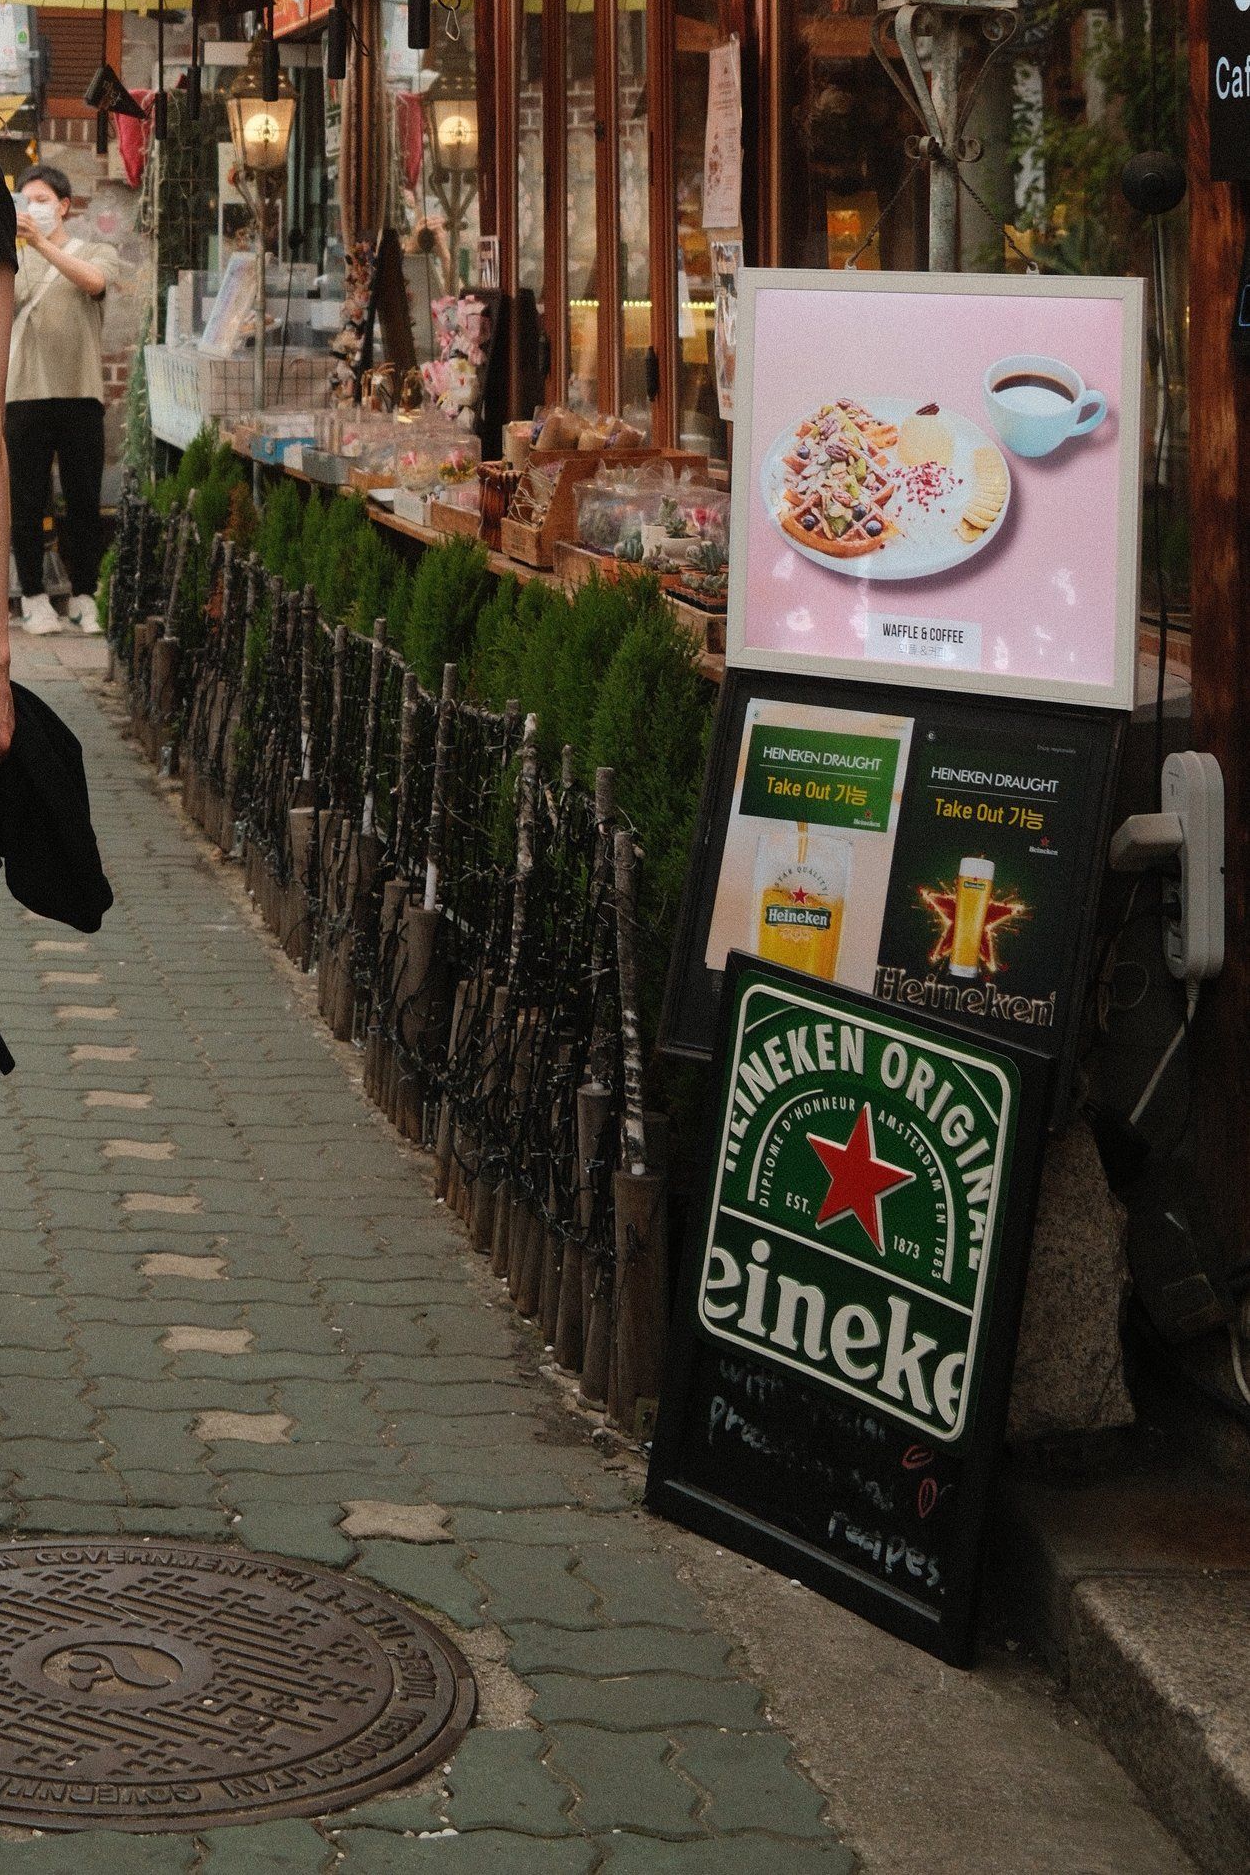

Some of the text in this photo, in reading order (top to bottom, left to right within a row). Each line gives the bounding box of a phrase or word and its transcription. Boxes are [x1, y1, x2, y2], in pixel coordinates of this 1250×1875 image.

[882, 623, 964, 644] WAFFLE & COFFEE
[762, 746, 883, 772] HEINEKEN DRAUGHT
[766, 776, 868, 807] Take Out 가능
[931, 766, 1060, 794] HEINEKEN DRAUGHT
[935, 797, 1045, 831] Take Out 가능
[796, 866, 829, 892] QUALITY
[768, 908, 829, 927] Heineken
[875, 965, 1056, 1027] Heineken
[758, 1096, 947, 1279] DIPLOME D'HONNEUR AMSTERDAM EN 1883
[785, 1191, 813, 1216] EST.
[892, 1235, 921, 1260] 1873
[36, 1549, 263, 1579] GOVERNMENT
